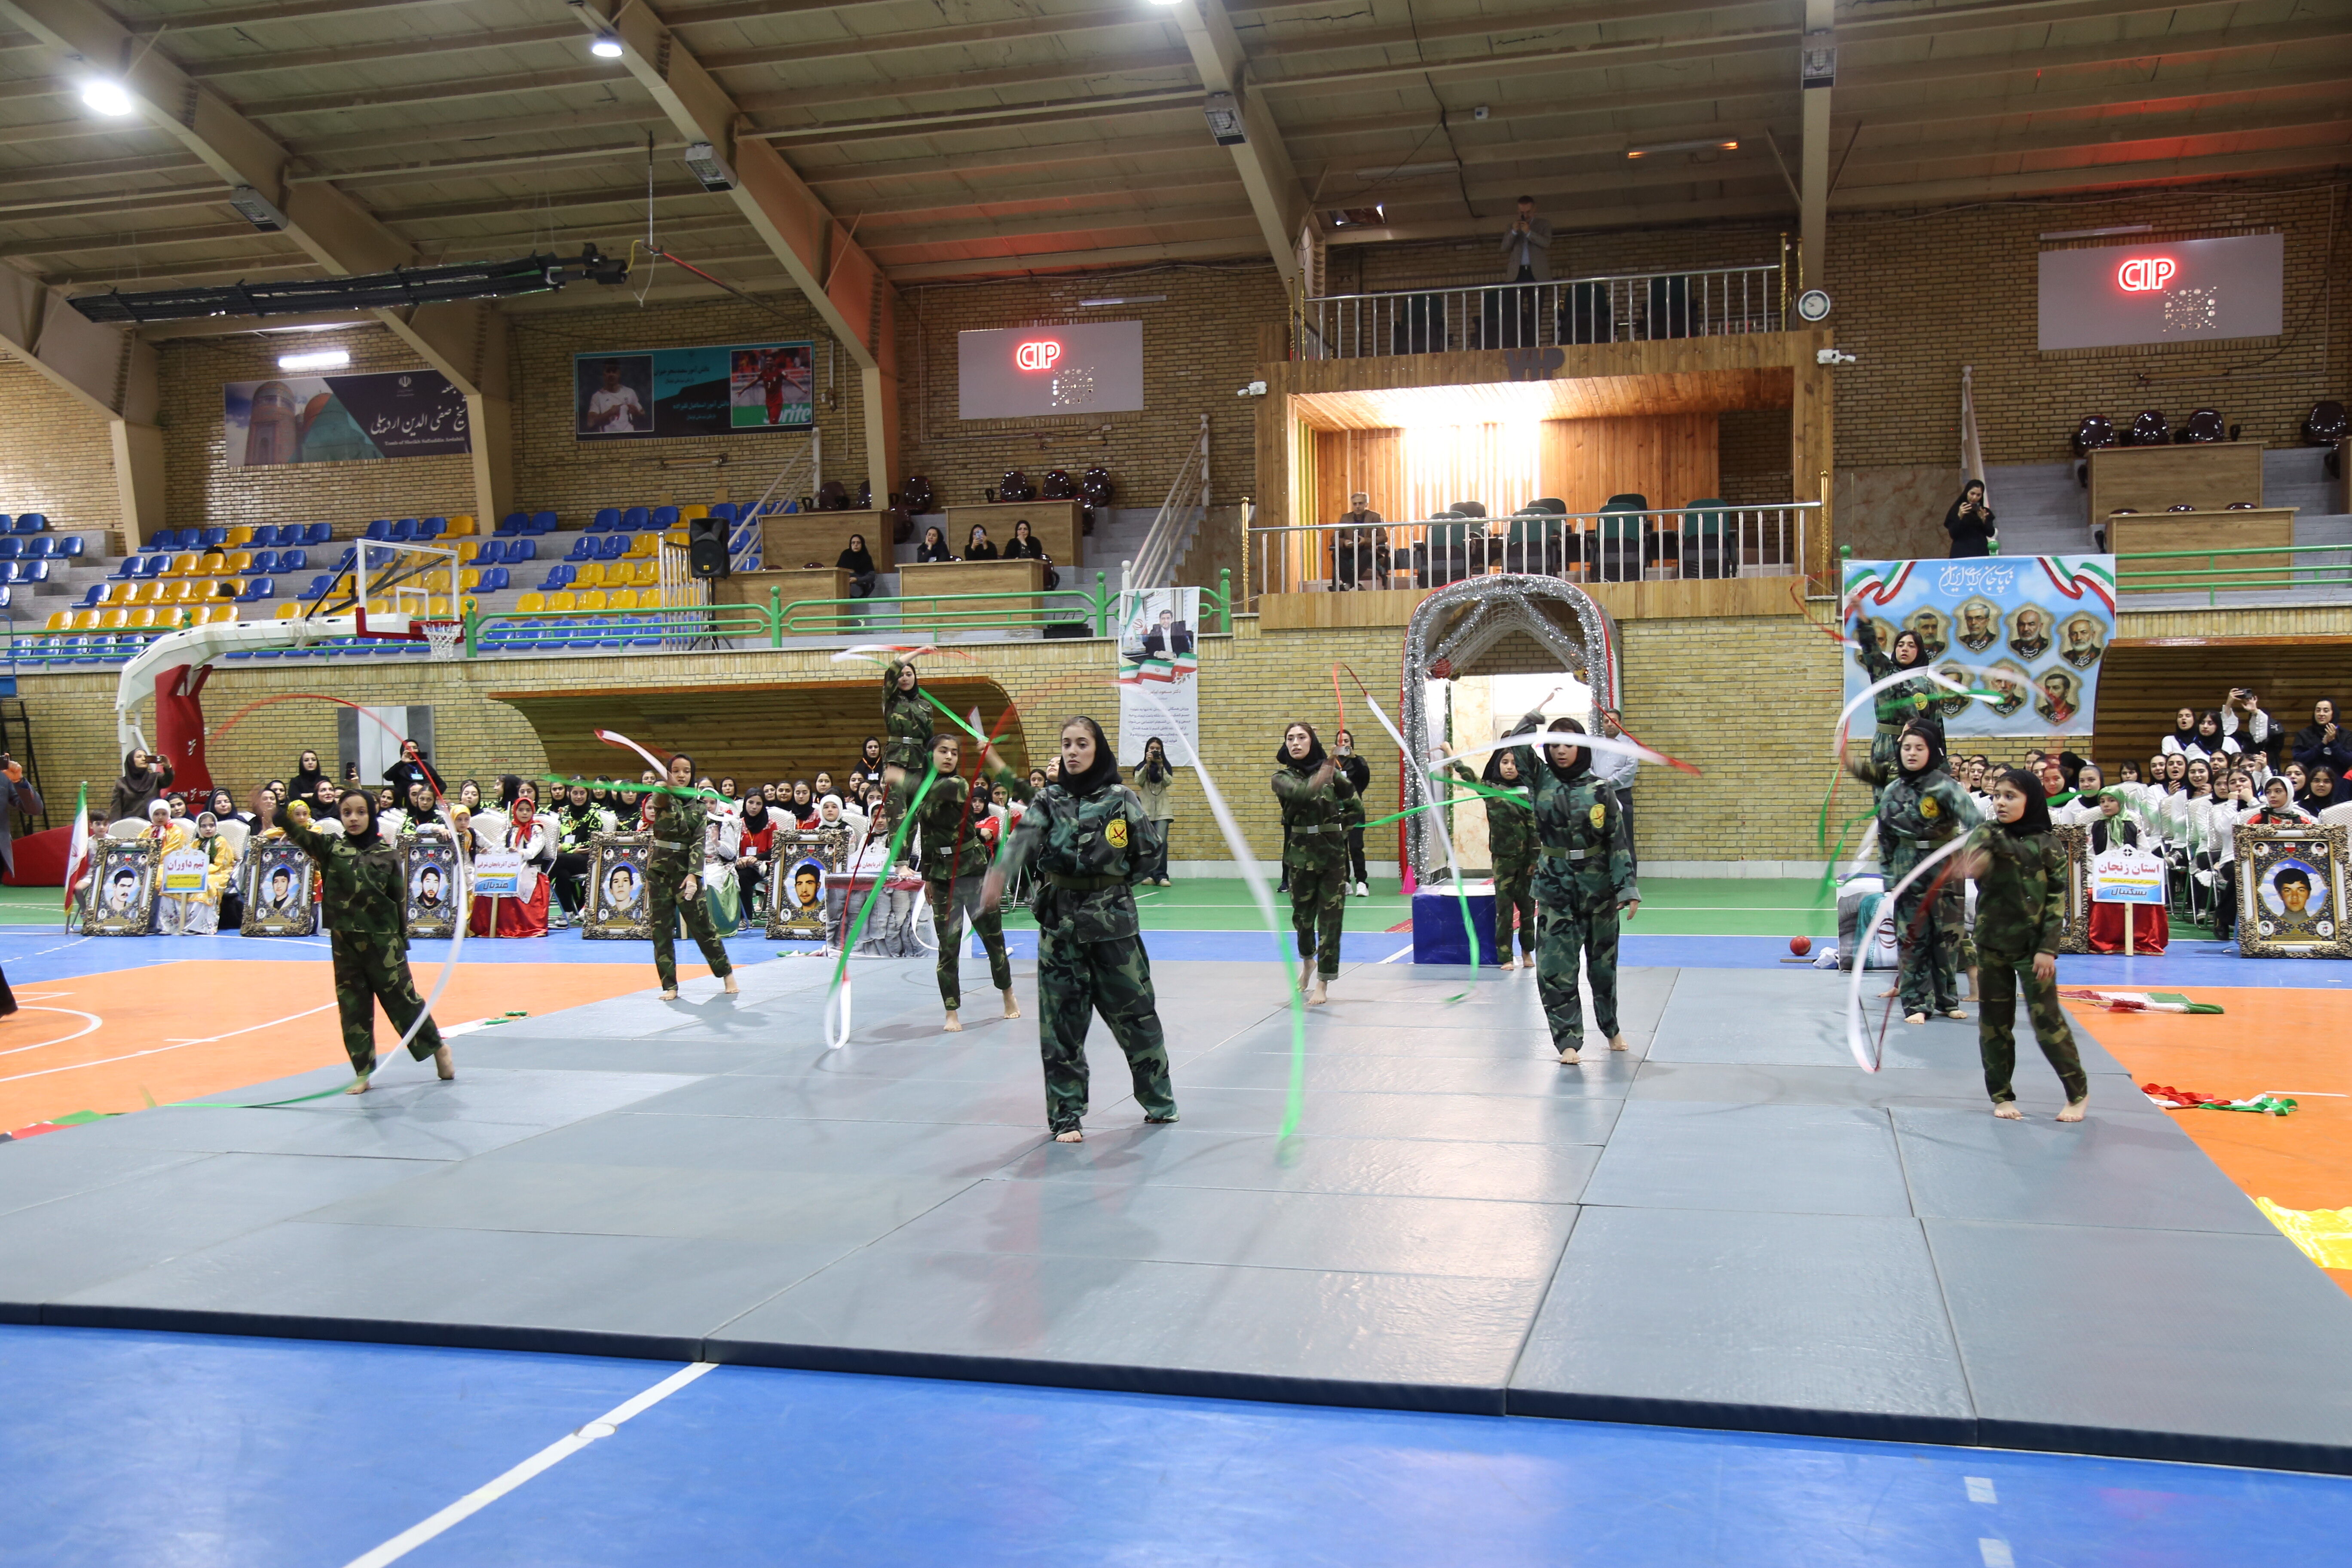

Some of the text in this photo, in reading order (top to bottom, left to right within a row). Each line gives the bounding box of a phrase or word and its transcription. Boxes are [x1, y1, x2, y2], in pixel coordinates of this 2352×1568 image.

[2118, 258, 2175, 291] CIP
[1017, 341, 1060, 370] CIP
[1505, 348, 1565, 381] VIP
[371, 412, 400, 435] اردبیلی
[402, 413, 428, 436] الدین
[430, 405, 452, 431] صفی
[1939, 561, 1968, 597] ایران
[1965, 565, 1983, 592] برای
[167, 858, 205, 871] تیم داوران
[862, 861, 883, 869] آذربایجان
[2098, 861, 2159, 875] استان زنجان
[483, 881, 508, 890] هندبال
[2110, 887, 2147, 897] بسکتبال
